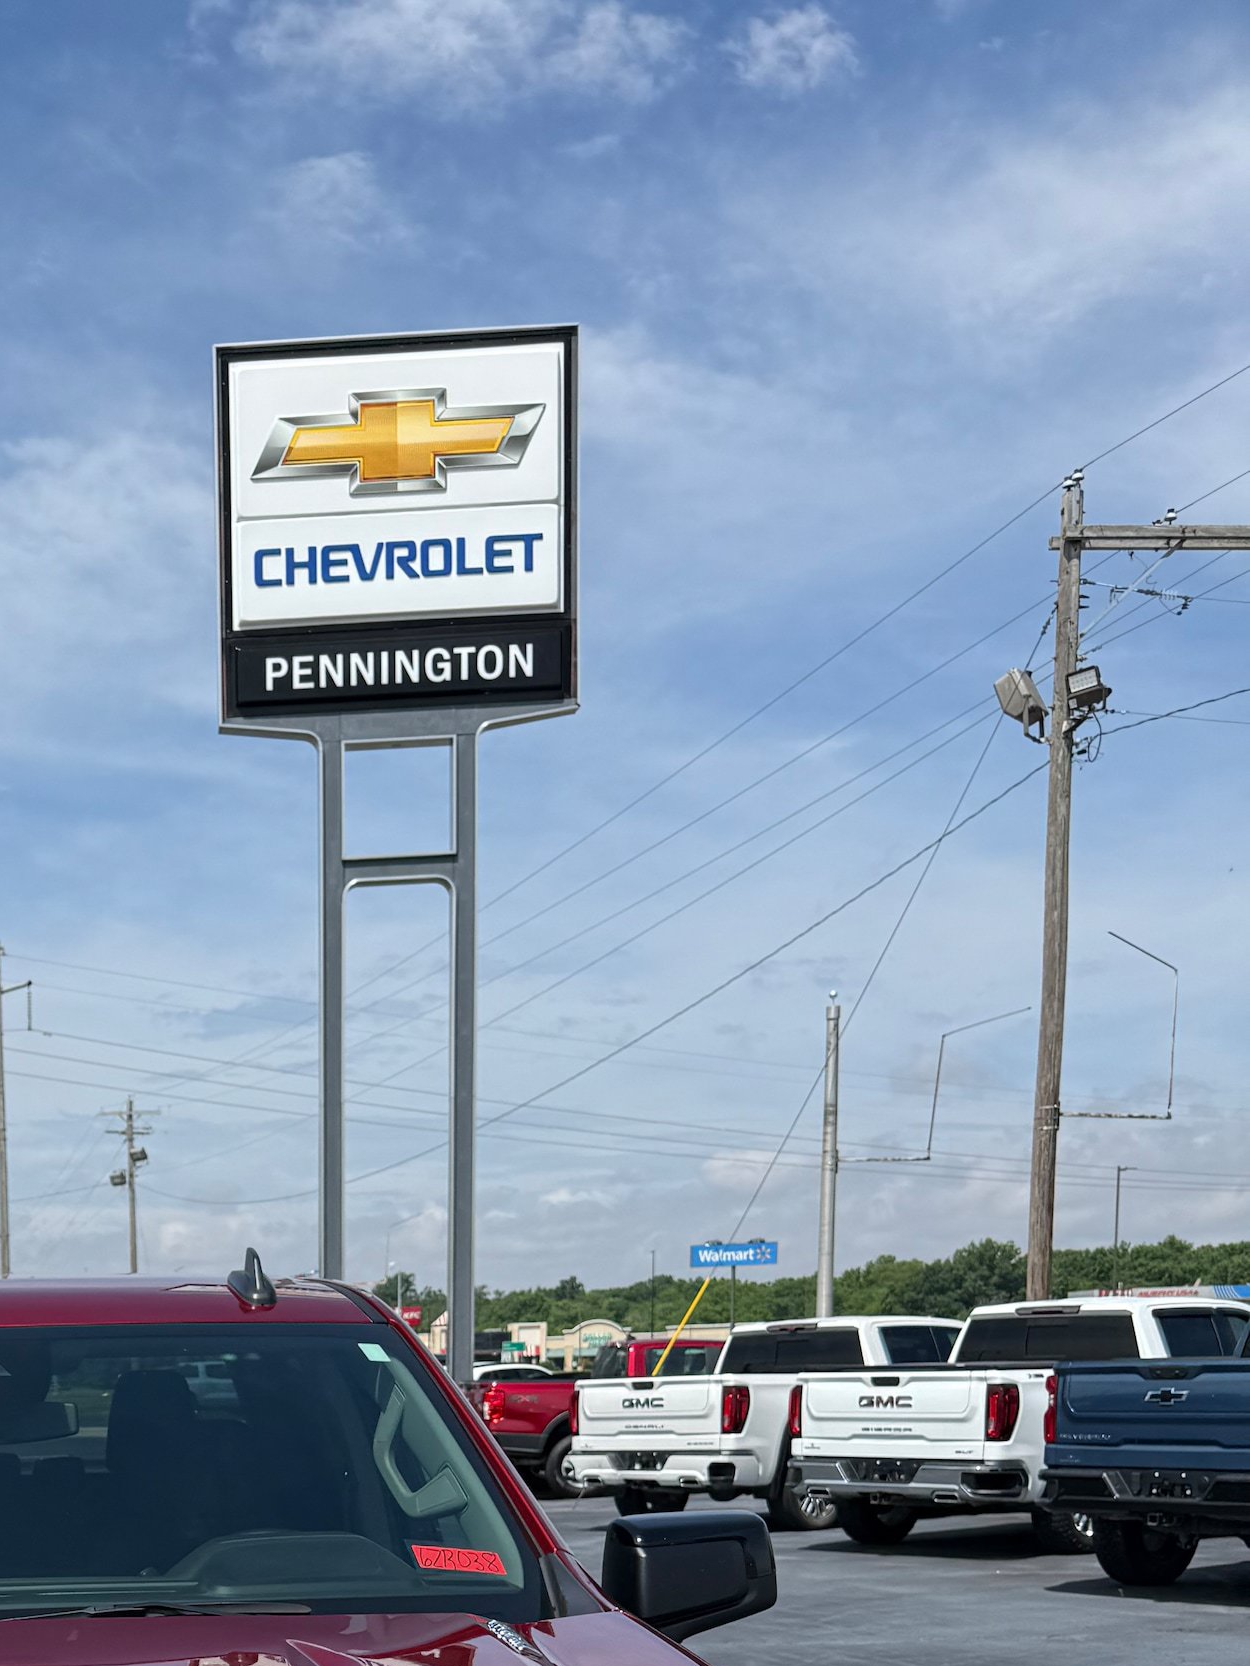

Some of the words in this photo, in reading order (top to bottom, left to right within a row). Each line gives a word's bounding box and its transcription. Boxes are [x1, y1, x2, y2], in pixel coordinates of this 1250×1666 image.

[253, 533, 543, 587] CHEVROLET
[265, 643, 534, 692] PENNINGTON
[698, 1247, 754, 1263] Walmart
[403, 1311, 421, 1320] KFC
[622, 1397, 664, 1409] GMC
[858, 1395, 912, 1408] GMC
